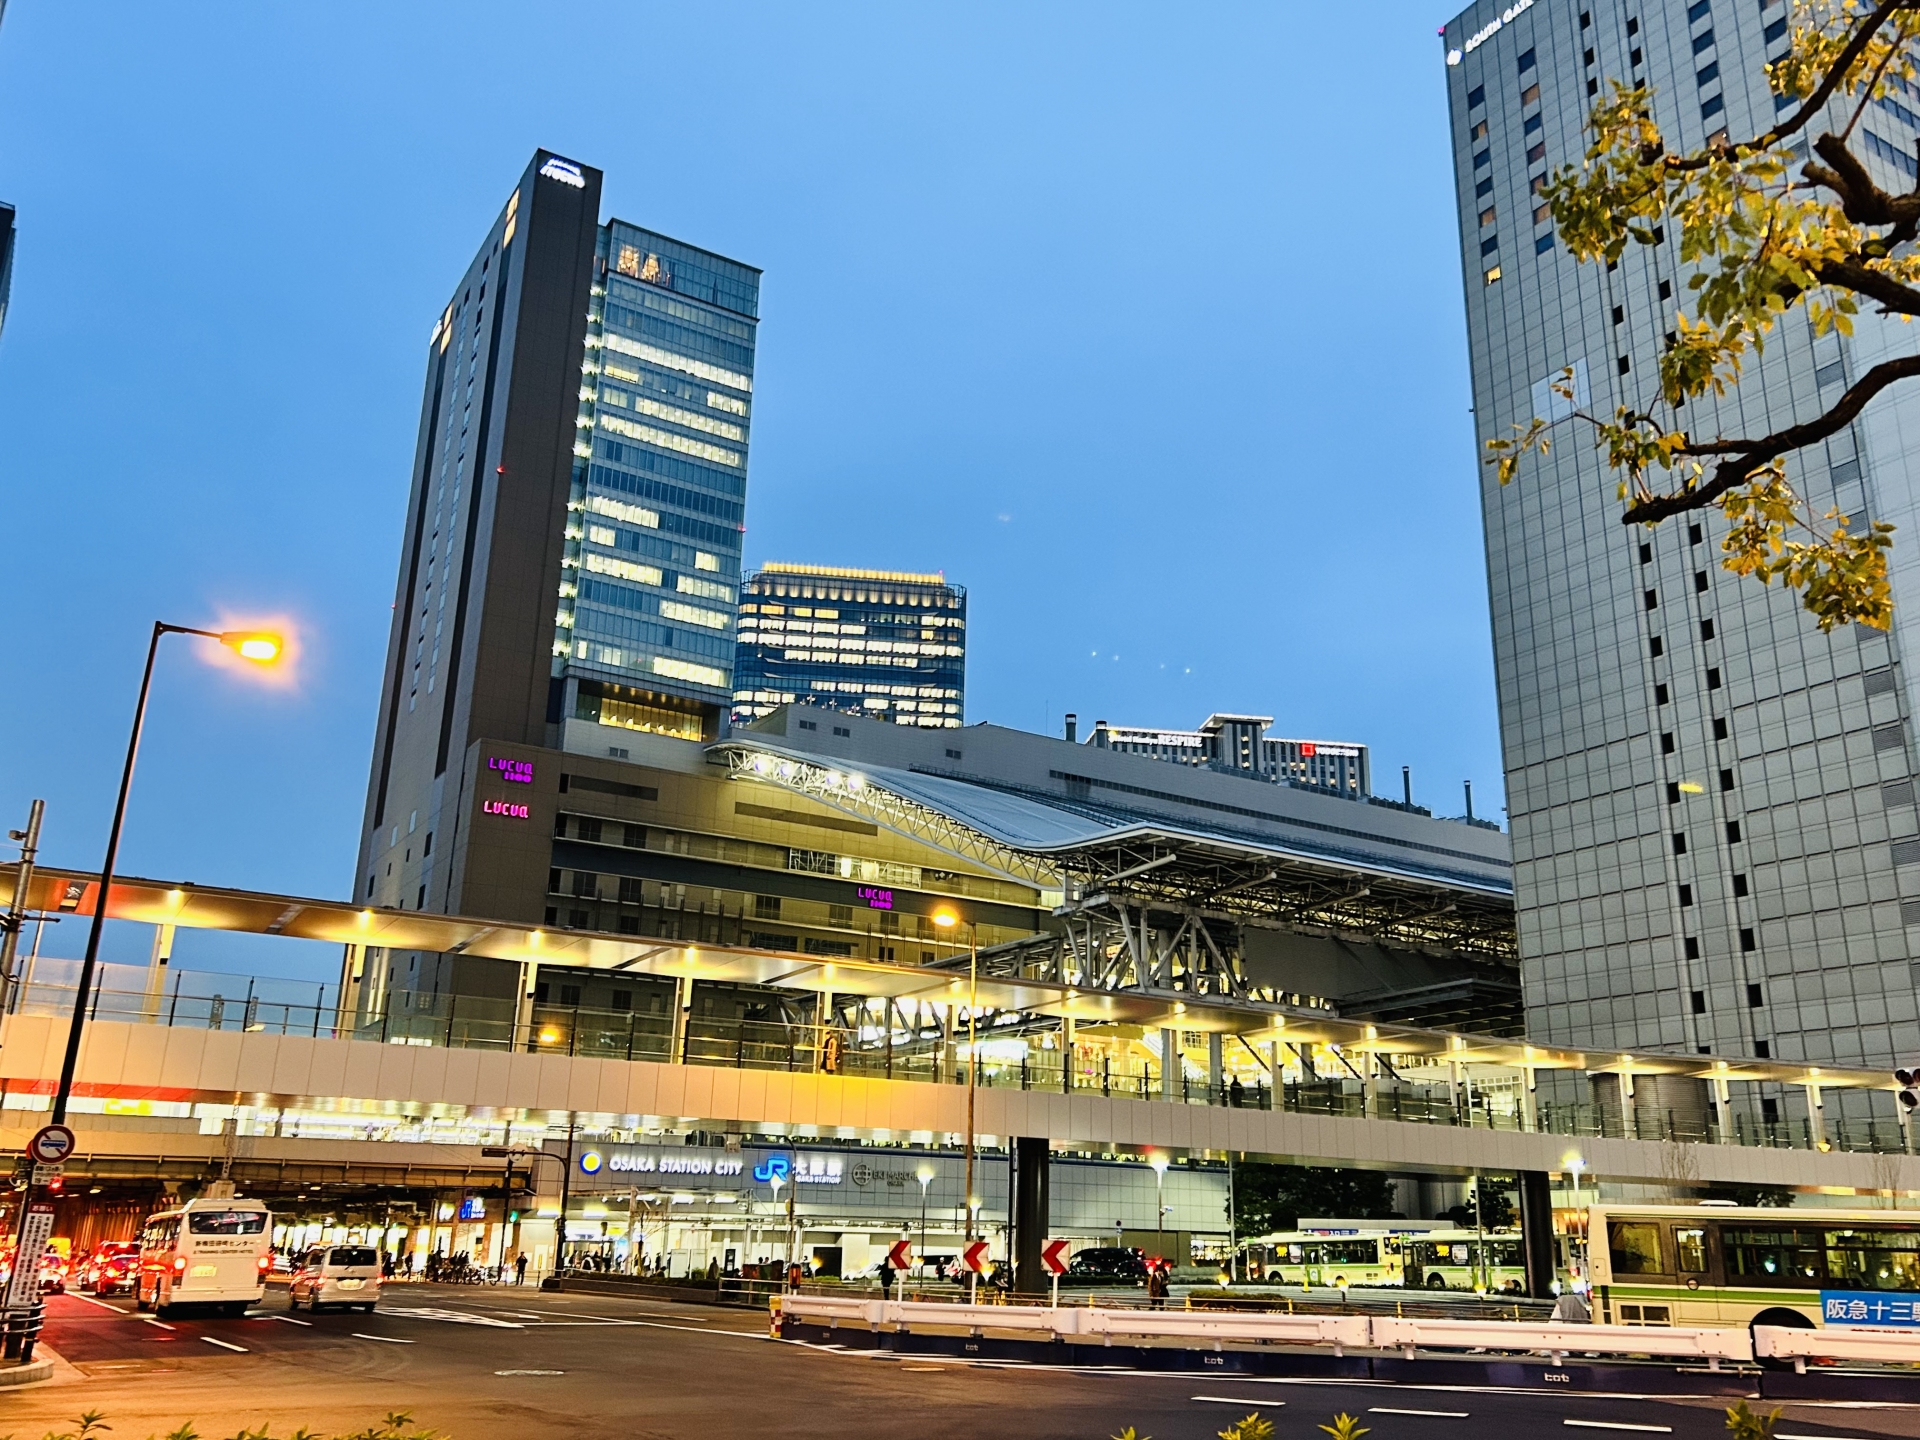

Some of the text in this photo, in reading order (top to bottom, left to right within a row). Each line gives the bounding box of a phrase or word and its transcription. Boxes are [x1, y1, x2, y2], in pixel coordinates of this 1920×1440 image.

[1465, 17, 1502, 53] SOUTH
[1158, 735, 1202, 747] RESPIRE
[609, 1155, 743, 1176] OSAKA STATION CITY
[754, 1157, 790, 1182] JR
